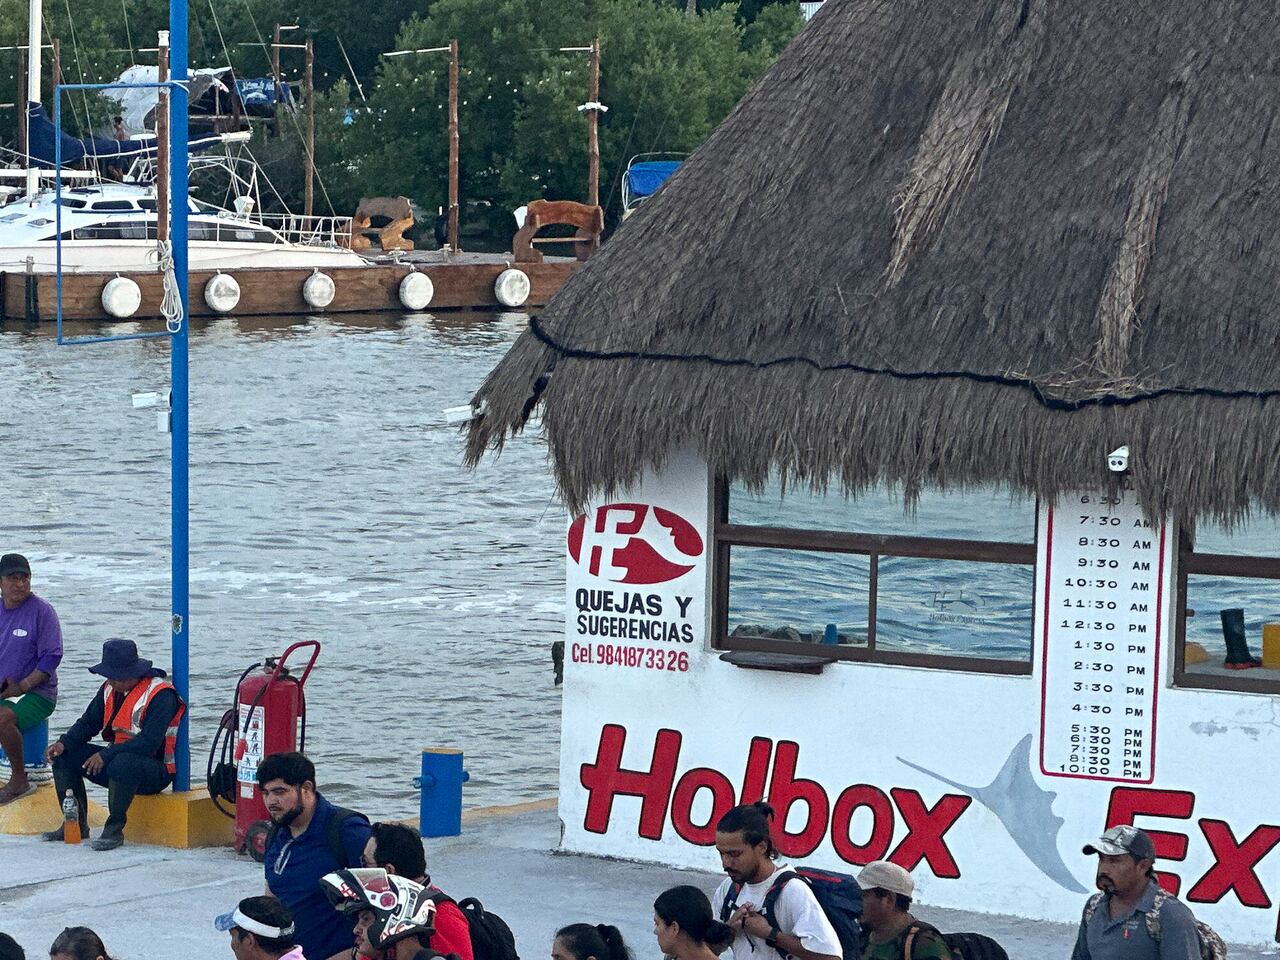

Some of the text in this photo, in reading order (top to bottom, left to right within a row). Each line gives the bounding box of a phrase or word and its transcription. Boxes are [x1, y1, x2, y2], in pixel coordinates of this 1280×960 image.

[1079, 515, 1121, 526] 7:30
[1078, 536, 1151, 550] 8:30 AM
[1078, 558, 1150, 571] 9:30 AM
[1065, 578, 1149, 591] 10:30 AM
[575, 588, 694, 618] QUEJAS Y
[1063, 598, 1148, 613] 11:30 AM
[577, 614, 694, 644] SUGERENCIAS
[1060, 620, 1147, 633] 12:30 PM
[572, 643, 595, 664] Cel.
[1074, 640, 1146, 654] 1:30 PM
[1073, 661, 1145, 675] 2:30 PM
[1073, 682, 1144, 696] 3:30 PM
[1072, 703, 1144, 717] 4:30 PM
[1071, 724, 1143, 738] 5:30 PM
[1070, 734, 1142, 748] 6:30 PM
[1071, 744, 1142, 758] 7:30 PM
[1069, 754, 1141, 769] 8:30 PM
[1060, 764, 1142, 779] 10:00 PM
[580, 723, 973, 879] Holbox
